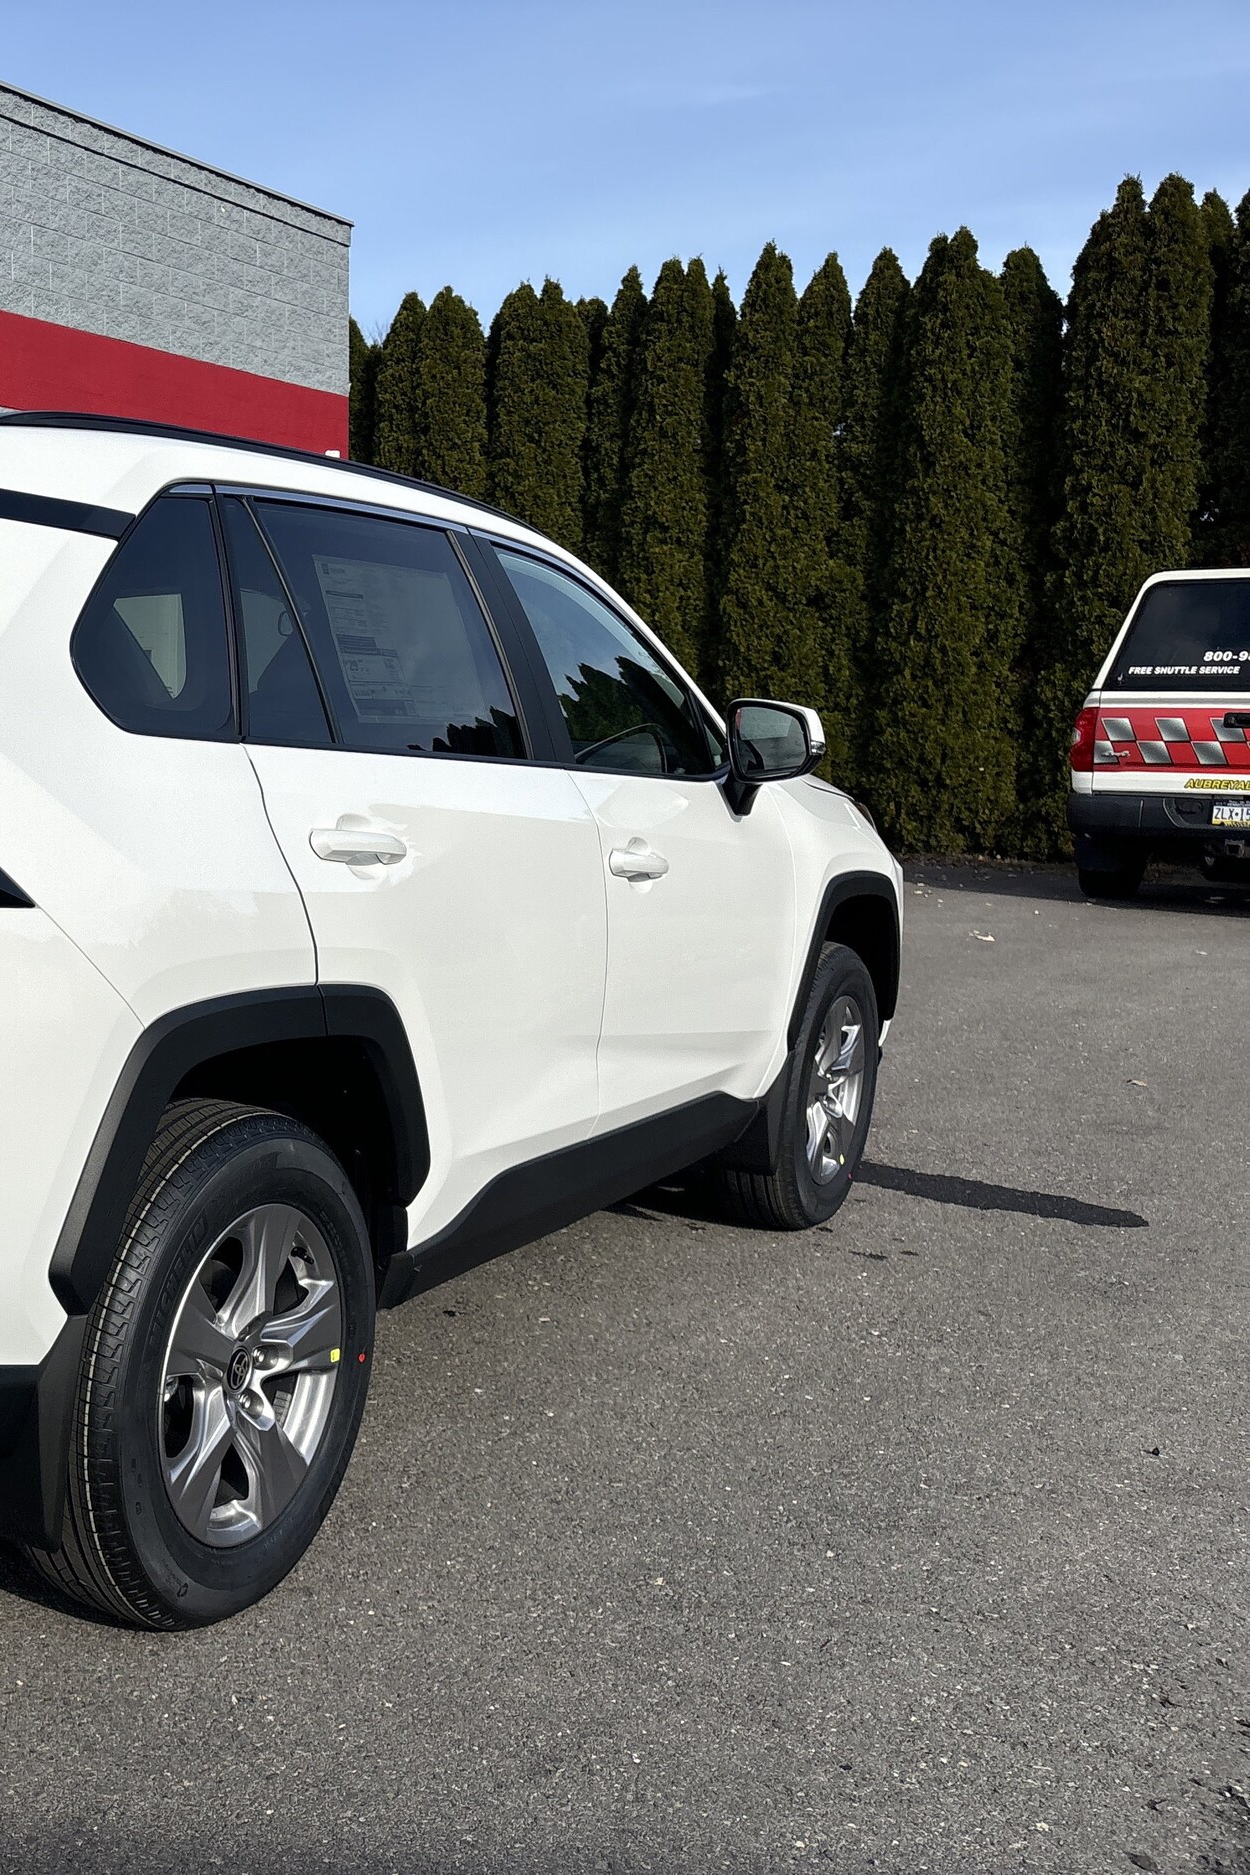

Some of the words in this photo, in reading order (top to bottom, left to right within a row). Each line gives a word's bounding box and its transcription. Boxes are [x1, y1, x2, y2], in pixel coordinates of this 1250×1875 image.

[1203, 650, 1250, 662] 800-9
[1128, 666, 1153, 675] FREE
[1154, 666, 1198, 675] SHUTTLE
[1198, 666, 1241, 674] SERVICE
